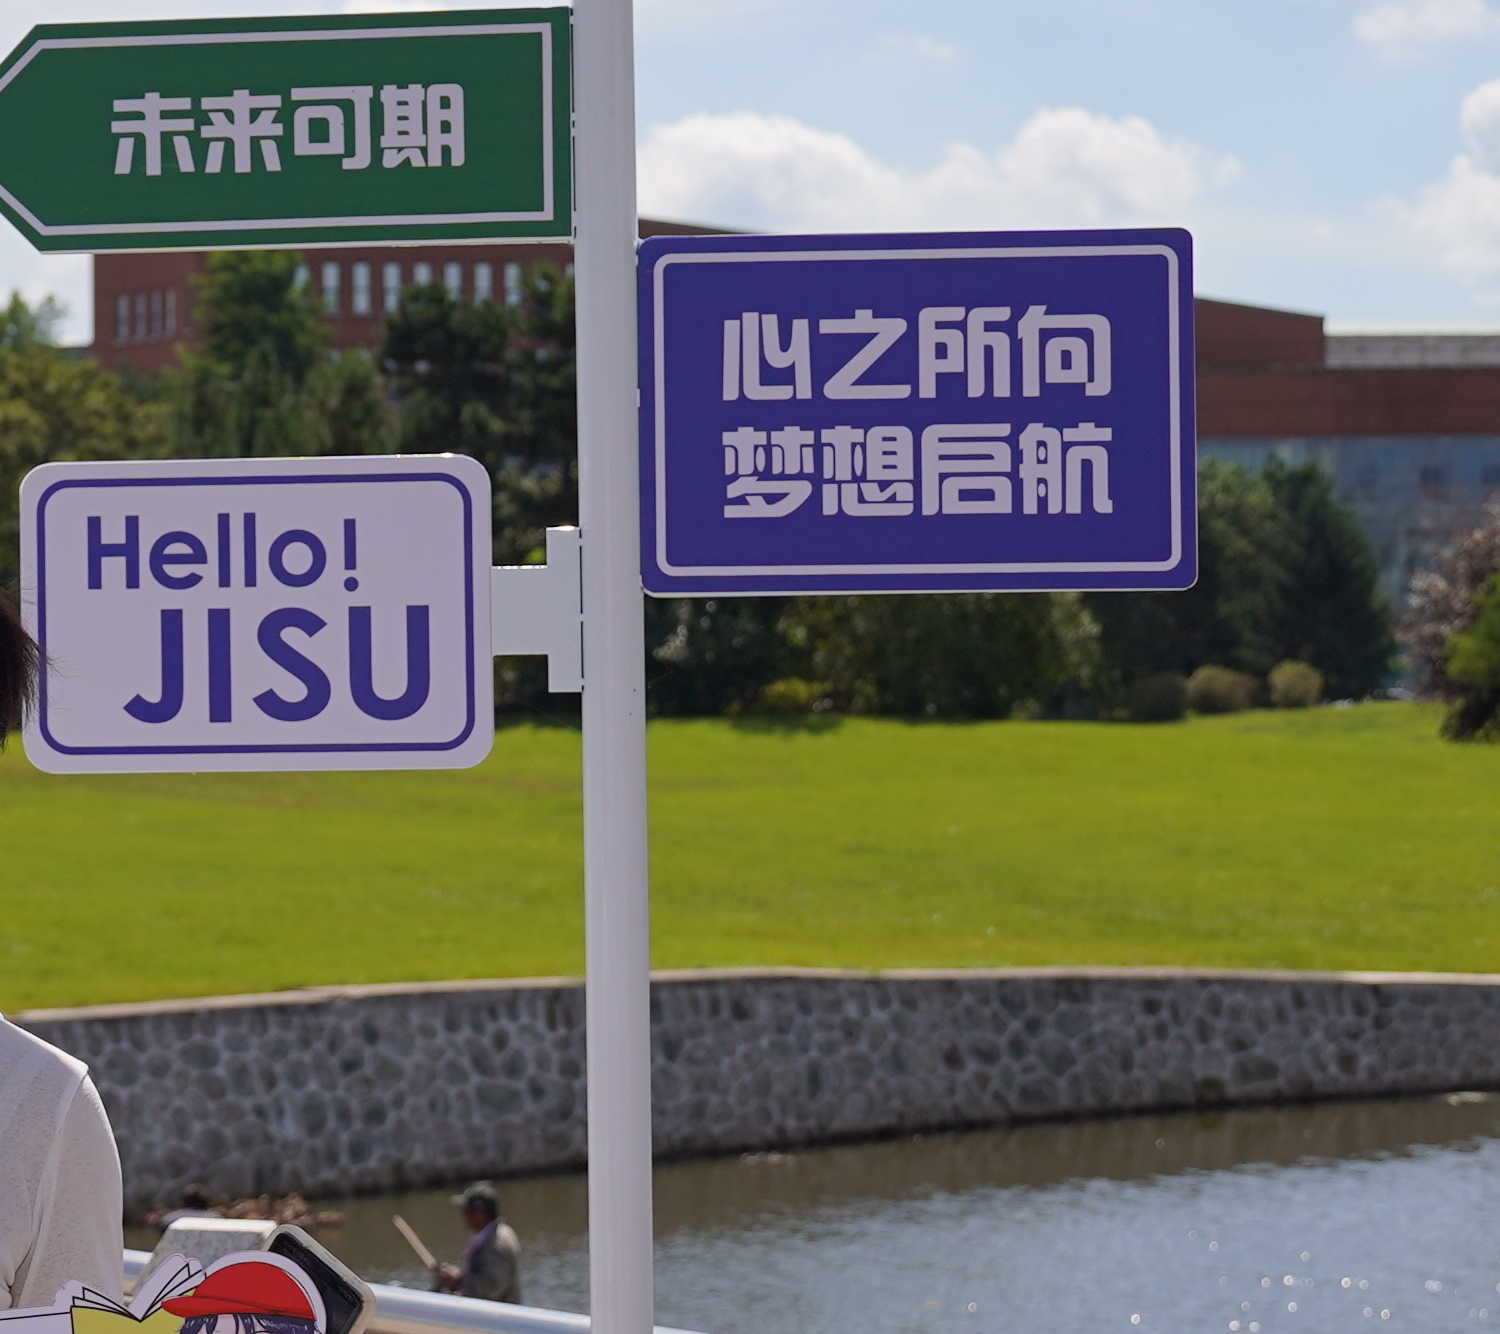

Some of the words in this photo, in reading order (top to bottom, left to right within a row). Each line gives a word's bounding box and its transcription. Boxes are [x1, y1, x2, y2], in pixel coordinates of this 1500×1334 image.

[110, 83, 466, 176] 未来可期
[722, 304, 1112, 401] 心之所向
[721, 422, 1113, 519] 梦想启航
[87, 512, 359, 593] Hello!
[122, 605, 431, 724] JISU
